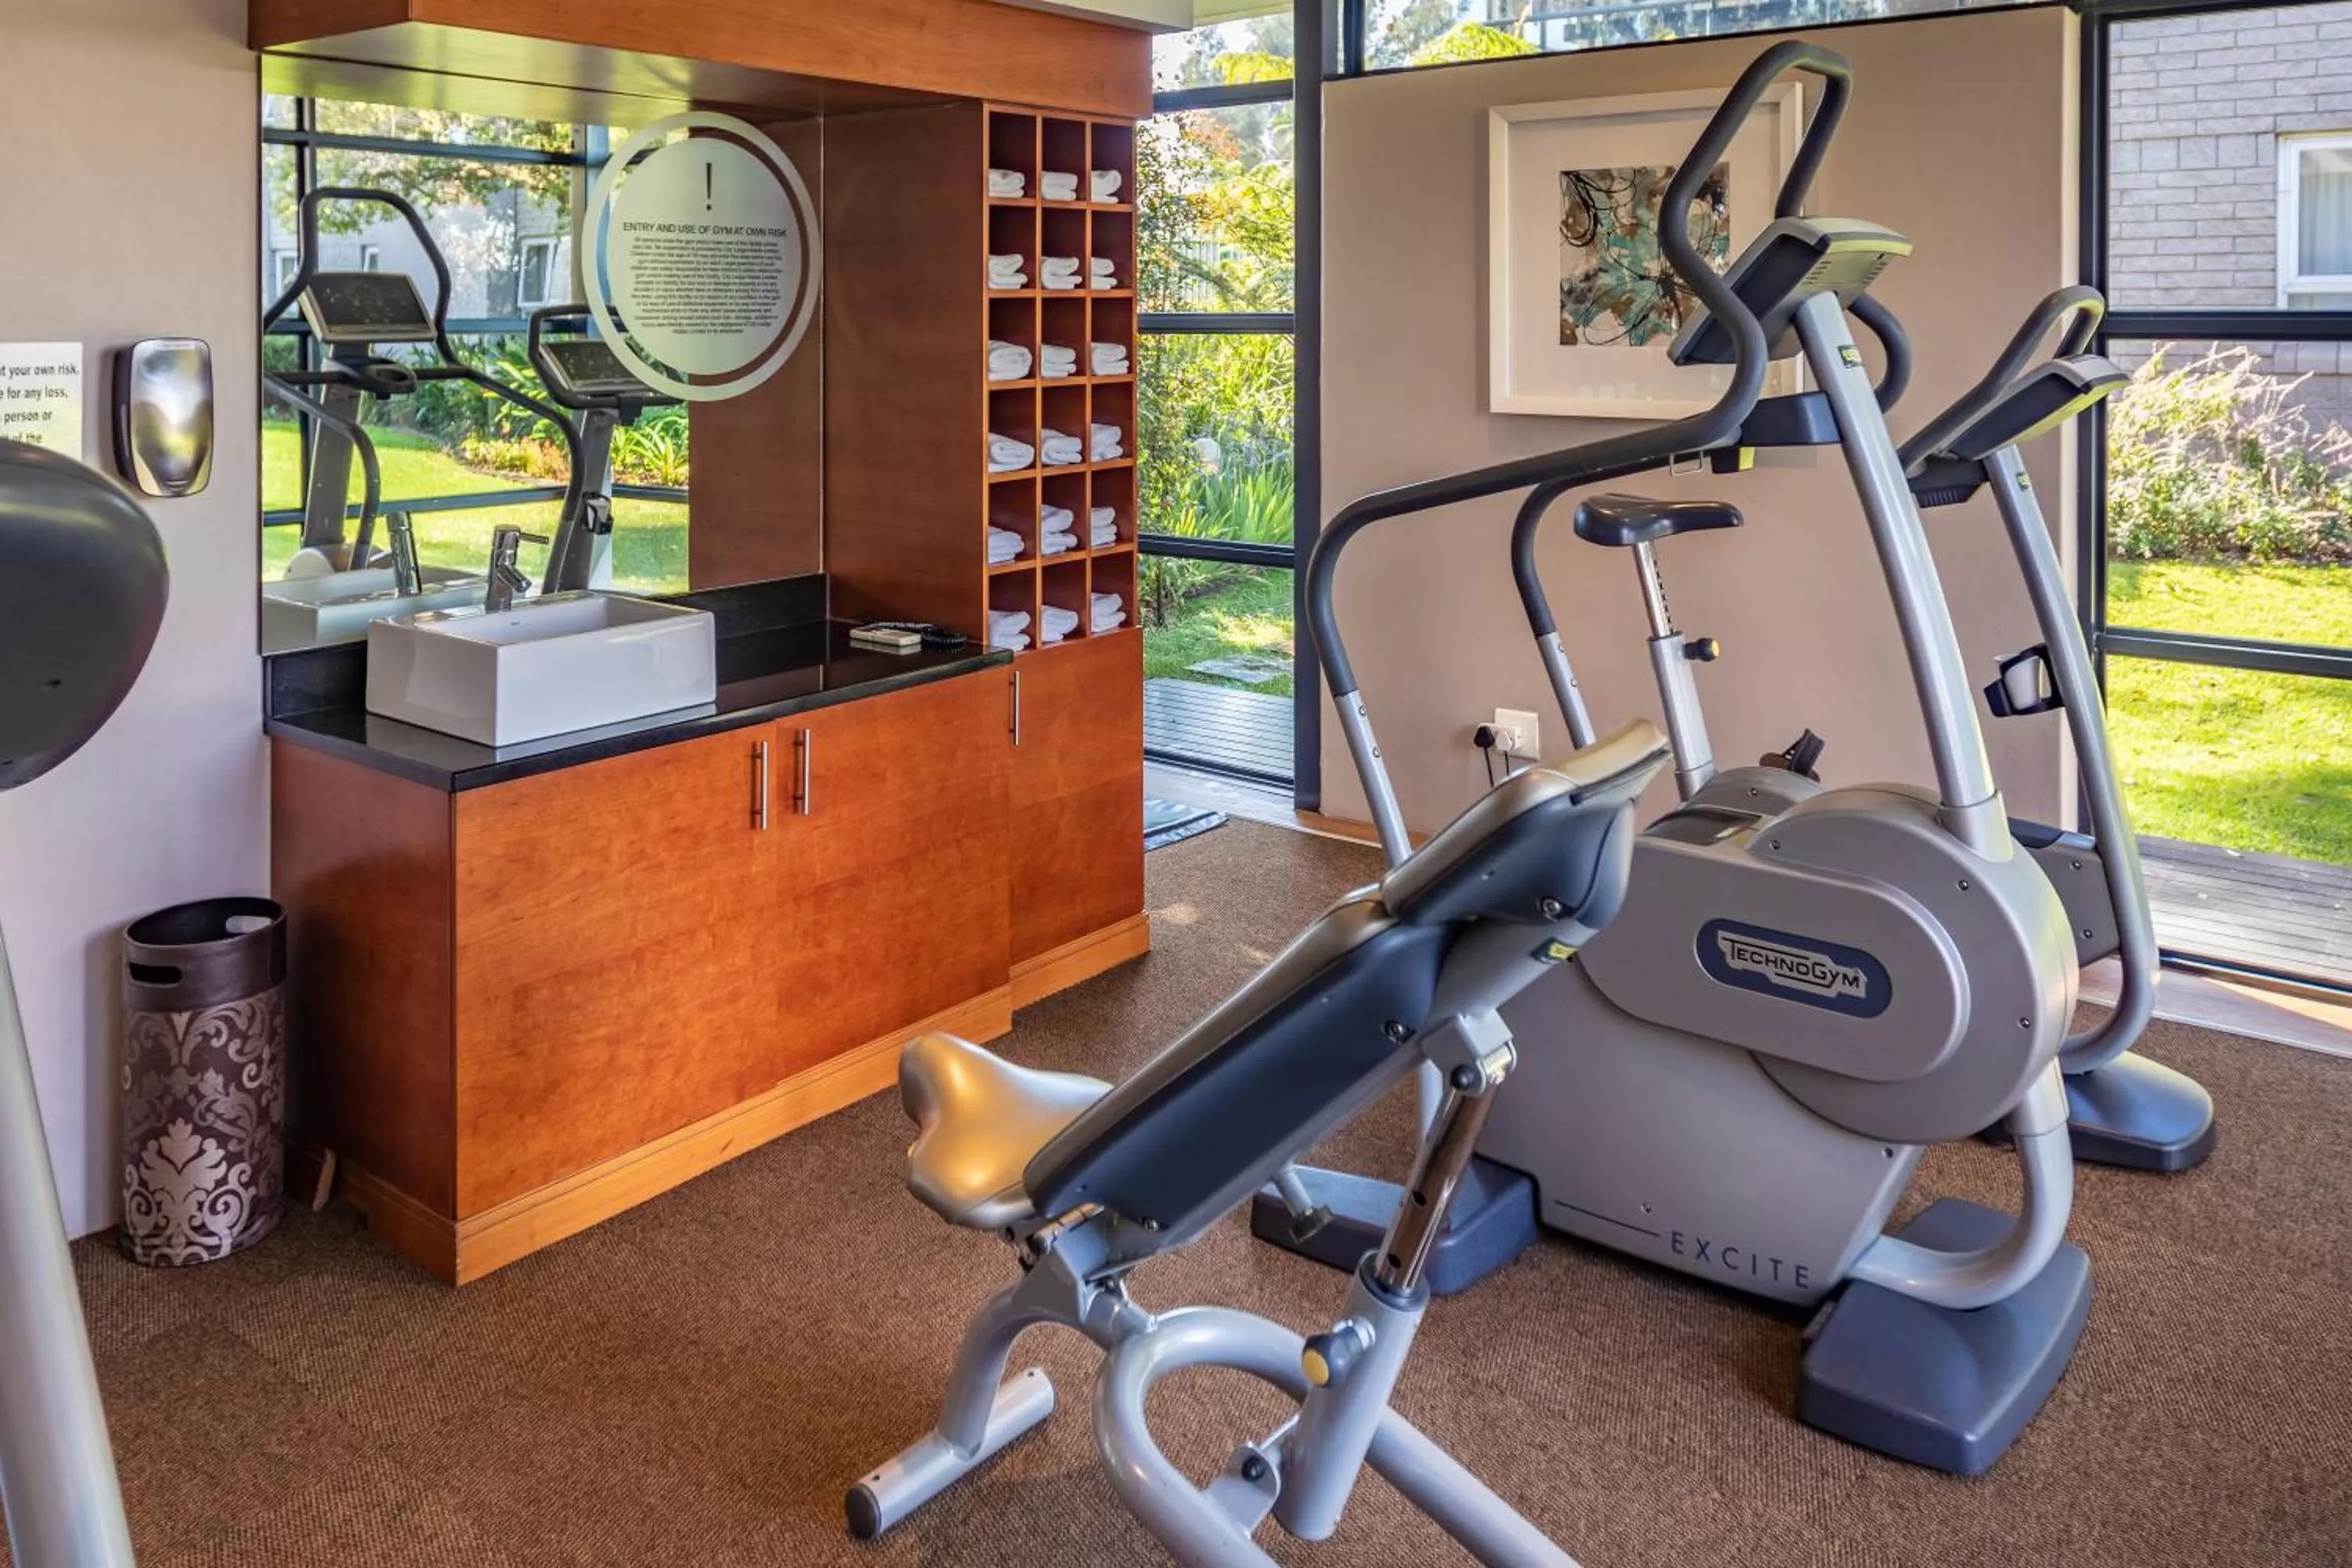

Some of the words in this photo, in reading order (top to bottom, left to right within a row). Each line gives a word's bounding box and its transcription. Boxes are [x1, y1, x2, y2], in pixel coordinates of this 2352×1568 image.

[623, 222, 654, 233] ENTRY
[655, 223, 676, 234] AND
[677, 224, 697, 234] USE
[699, 225, 711, 235] OF
[713, 225, 733, 236] GYM
[733, 226, 745, 236] AT
[746, 227, 766, 238] OWN
[768, 228, 787, 238] RISK
[9, 365, 31, 380] your
[34, 366, 55, 376] own
[7, 386, 21, 398] for
[24, 389, 42, 401] any
[45, 383, 68, 399] loss,
[4, 412, 39, 426] person
[42, 411, 53, 421] or
[26, 432, 42, 444] the
[1671, 1231, 1810, 1288] EXCITE
